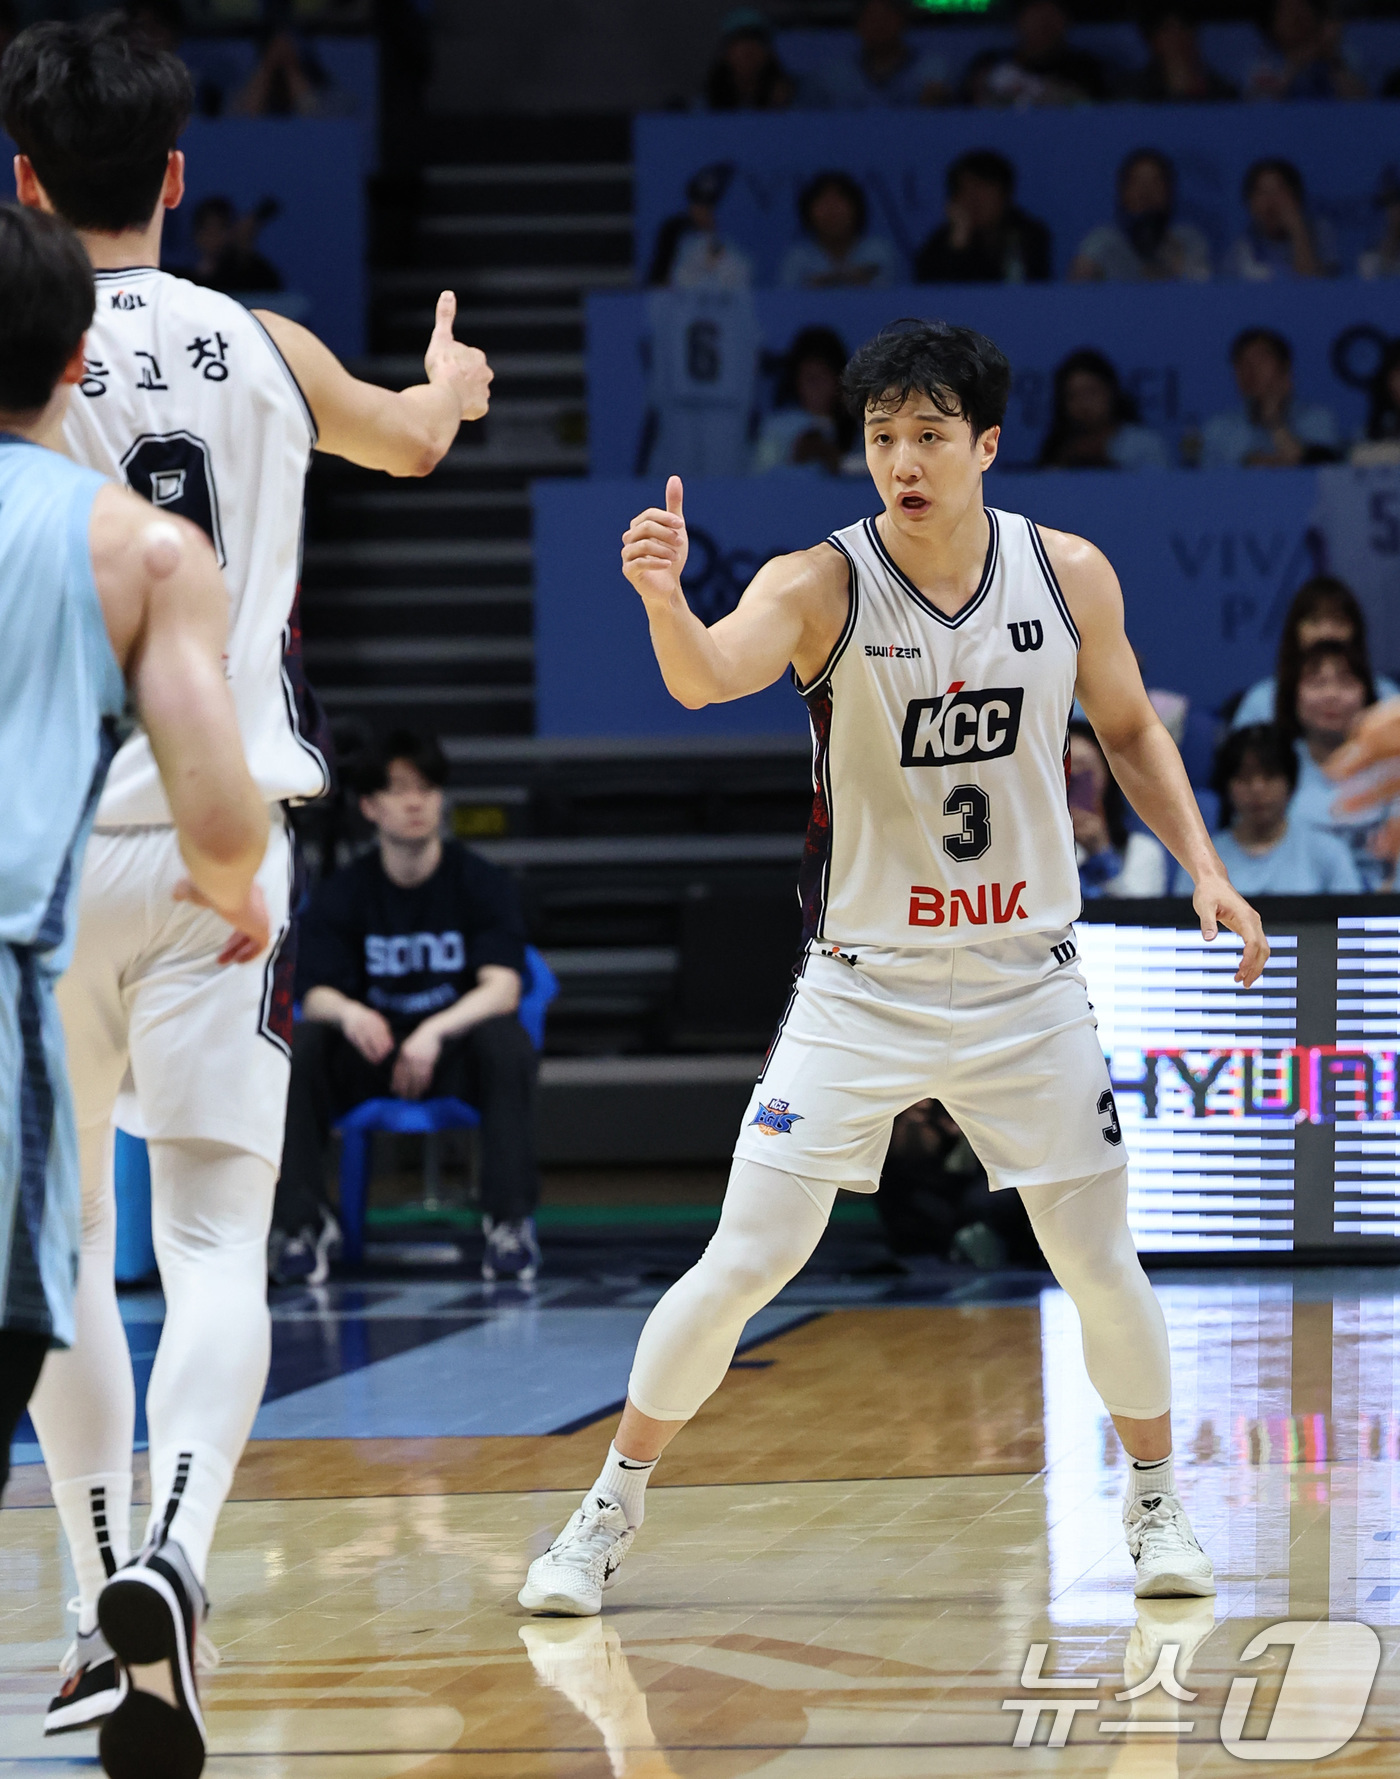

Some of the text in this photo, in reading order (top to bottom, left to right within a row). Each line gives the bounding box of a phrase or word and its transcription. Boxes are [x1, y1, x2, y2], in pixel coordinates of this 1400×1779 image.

[910, 681, 1012, 759] KCC
[943, 784, 991, 862] 3
[908, 881, 1029, 927] BNK
[1096, 1088, 1123, 1147] 3
